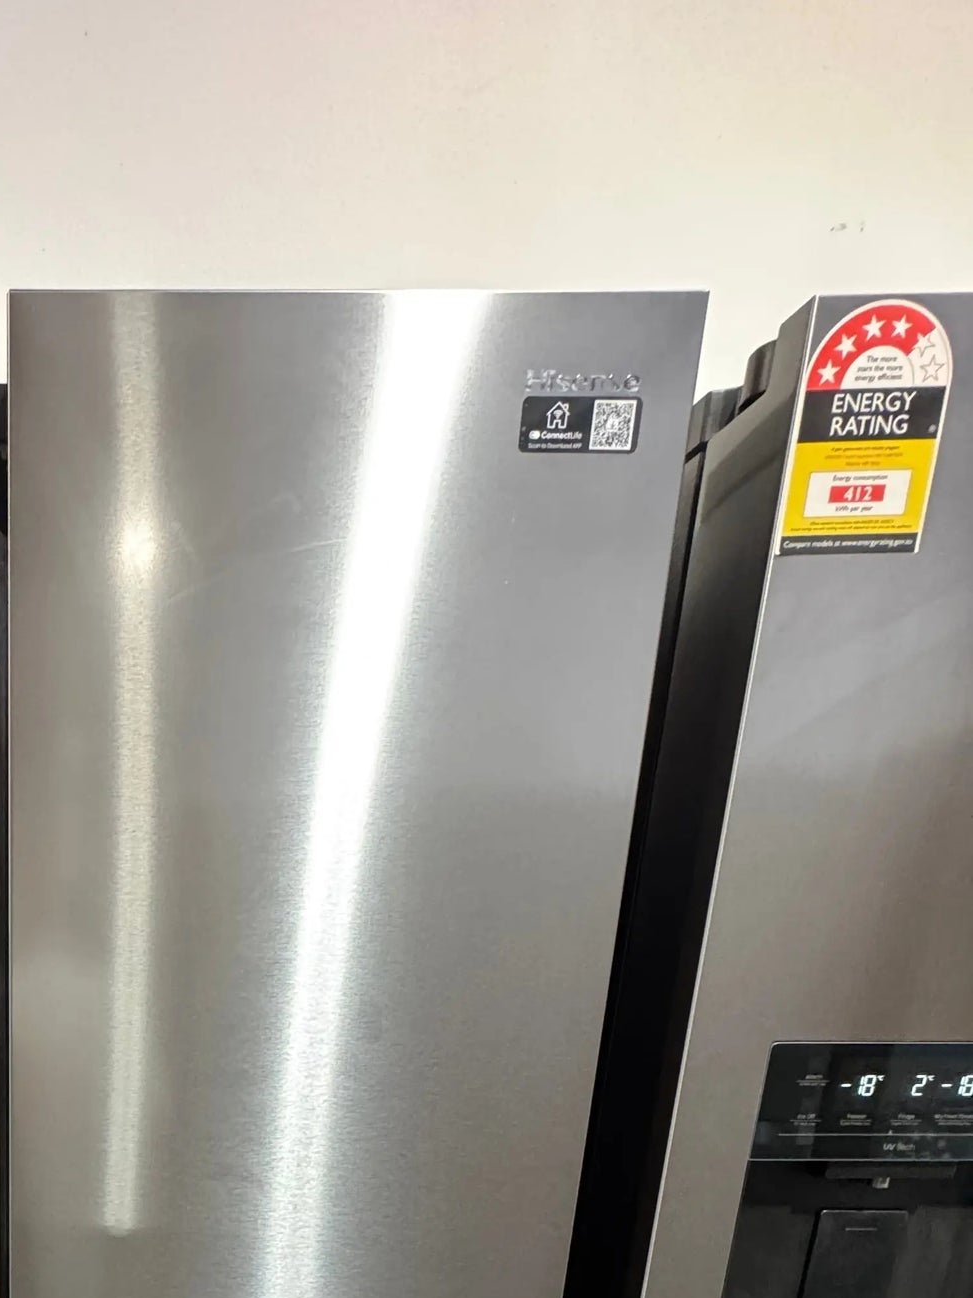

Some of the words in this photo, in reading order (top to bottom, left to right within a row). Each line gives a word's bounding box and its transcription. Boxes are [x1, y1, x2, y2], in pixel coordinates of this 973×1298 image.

[867, 355, 879, 363] The
[874, 364, 885, 372] the
[525, 369, 641, 392] Hisense
[854, 374, 876, 383] energy
[877, 372, 903, 381] efficient
[831, 391, 917, 413] ENERGY
[829, 414, 909, 437] RATING
[540, 431, 583, 440] ConnectLife
[833, 474, 852, 483] Energy
[853, 474, 888, 482] consumption
[843, 486, 873, 502] 412
[783, 540, 811, 549] Compare
[812, 539, 833, 548] models
